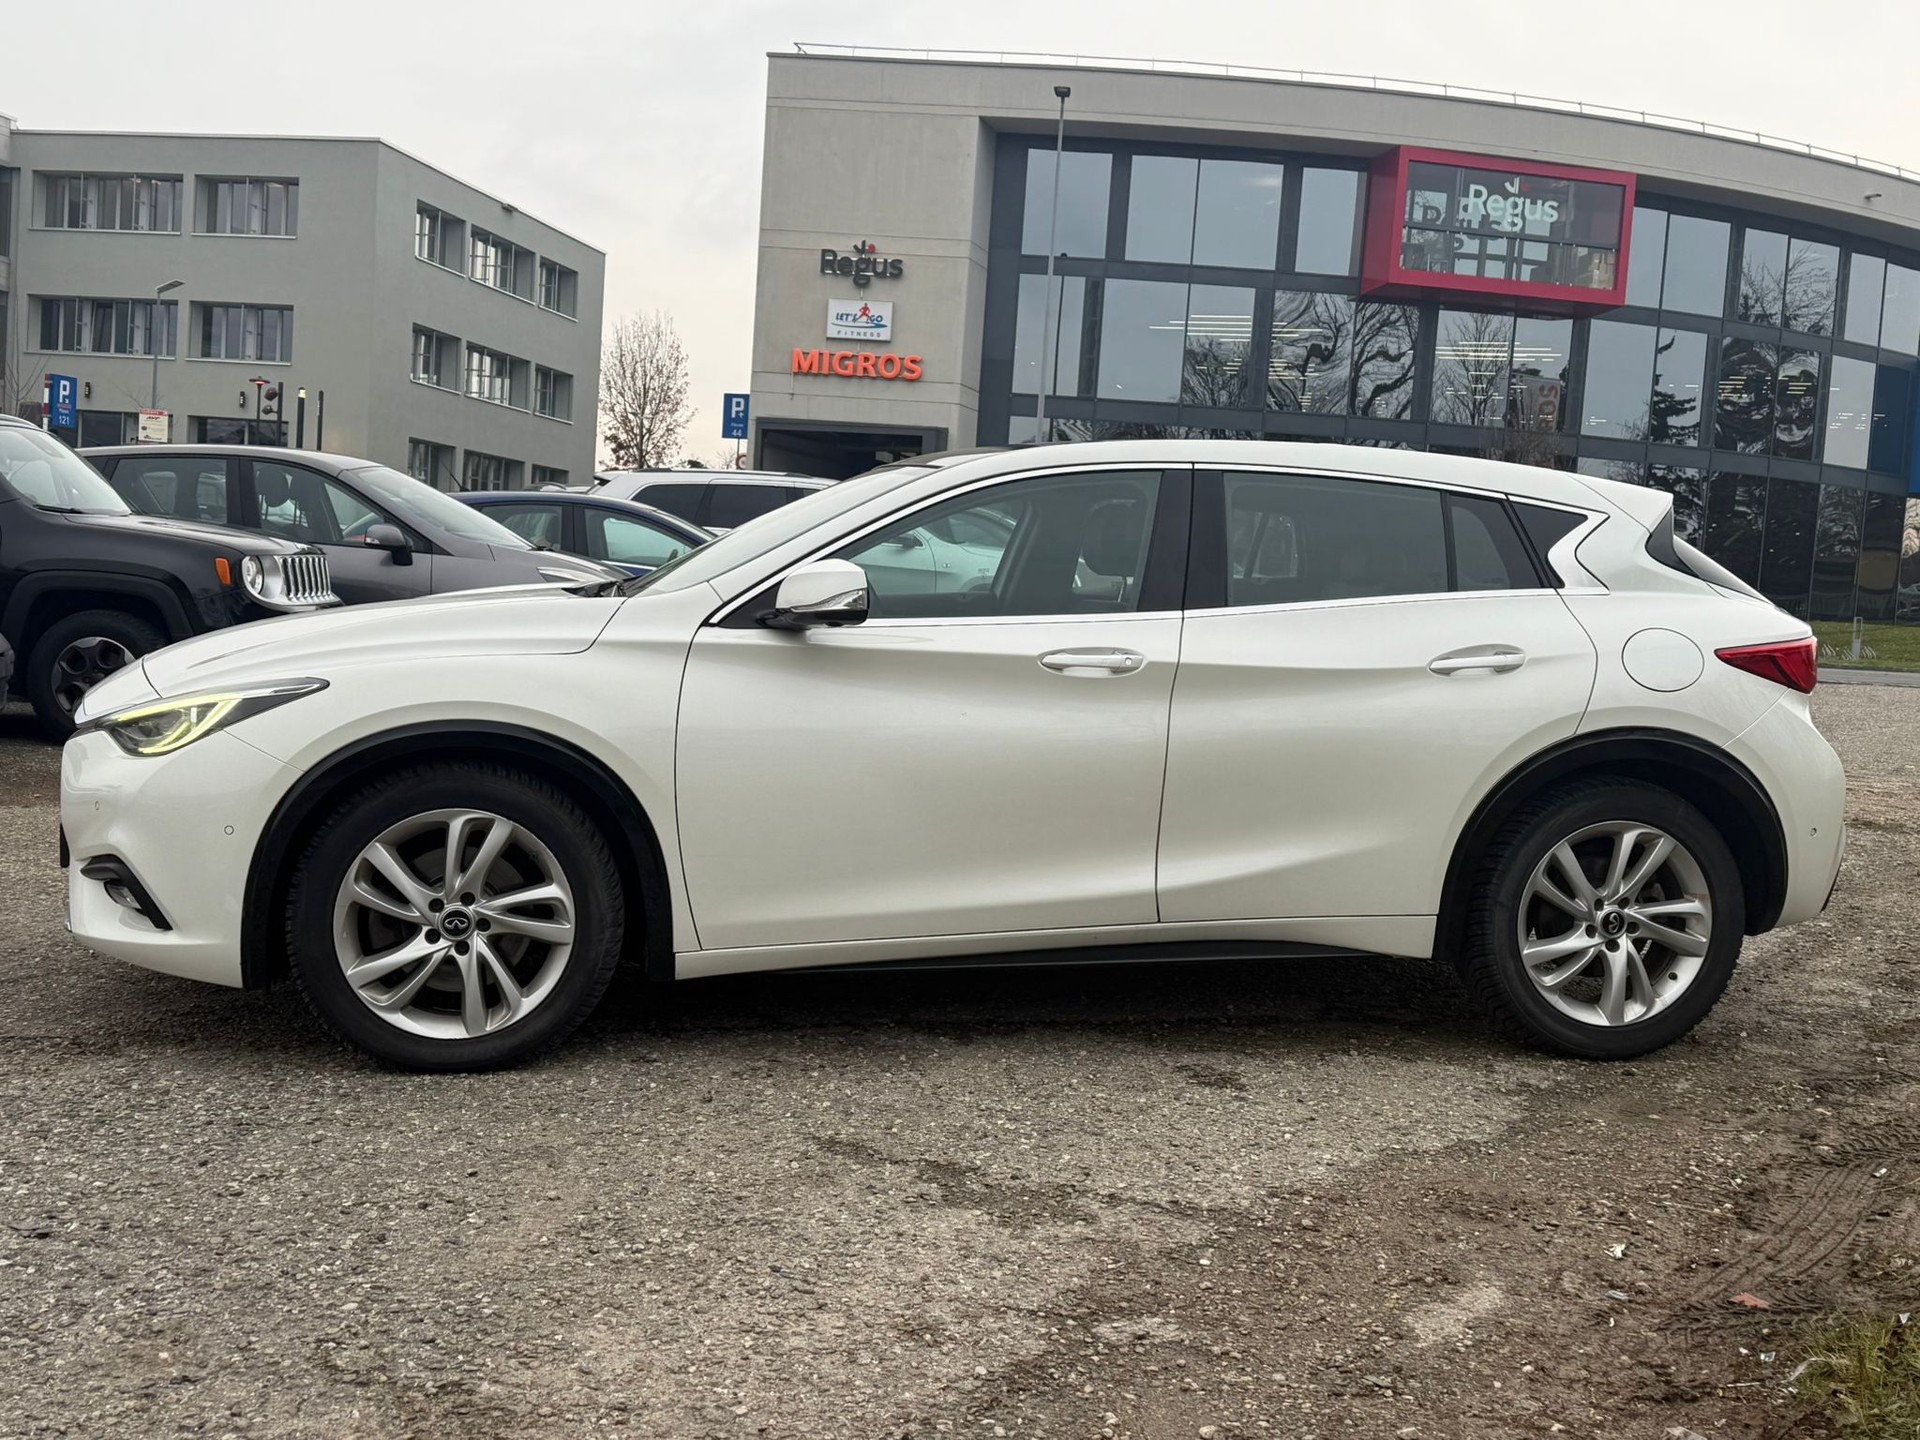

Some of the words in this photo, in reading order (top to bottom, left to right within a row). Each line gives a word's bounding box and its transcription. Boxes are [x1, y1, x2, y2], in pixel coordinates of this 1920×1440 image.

[1467, 183, 1559, 232] Regus
[820, 248, 904, 288] Regus
[836, 312, 858, 323] LET'S
[869, 314, 883, 323] GO
[791, 348, 923, 381] MIGROS
[59, 379, 71, 403] P
[731, 397, 745, 418] P
[58, 415, 70, 425] 121
